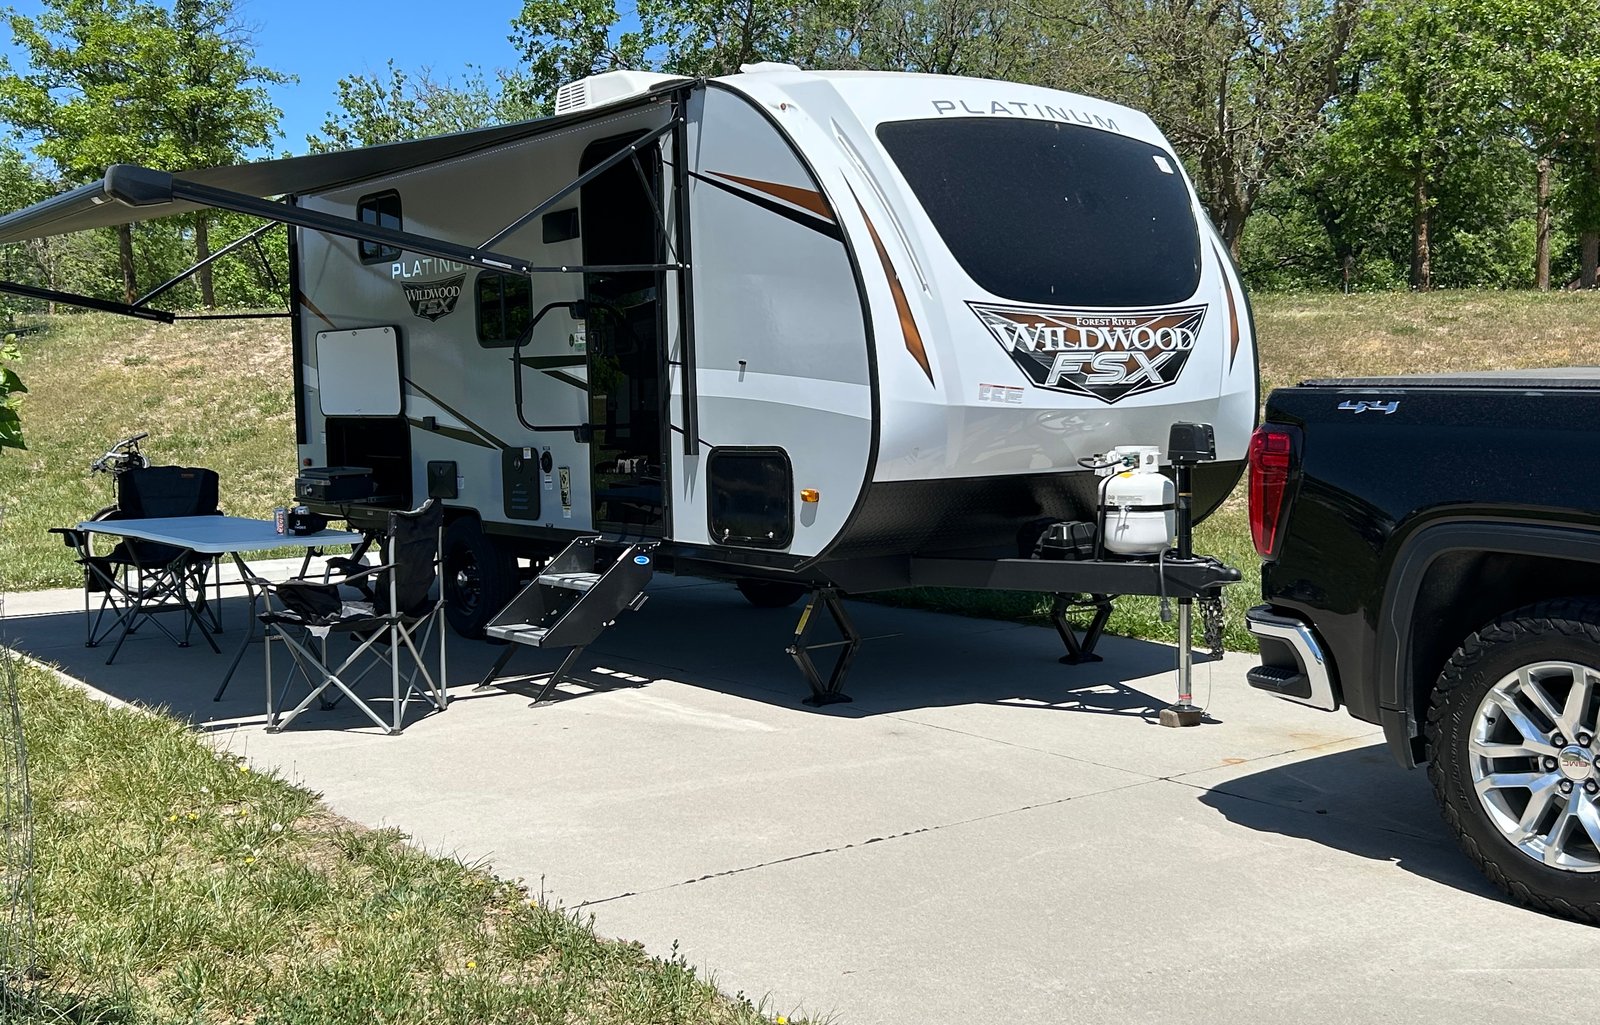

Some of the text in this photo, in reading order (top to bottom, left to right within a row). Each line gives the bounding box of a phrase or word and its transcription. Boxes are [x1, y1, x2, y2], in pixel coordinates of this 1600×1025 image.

[931, 99, 1121, 133] PLATINUM
[405, 285, 461, 302] WILDWOOD
[1075, 317, 1137, 326] FOREST RIVER
[991, 322, 1197, 352] WILDWOOD
[1044, 350, 1177, 386] FSX
[1561, 760, 1588, 768] GMC
